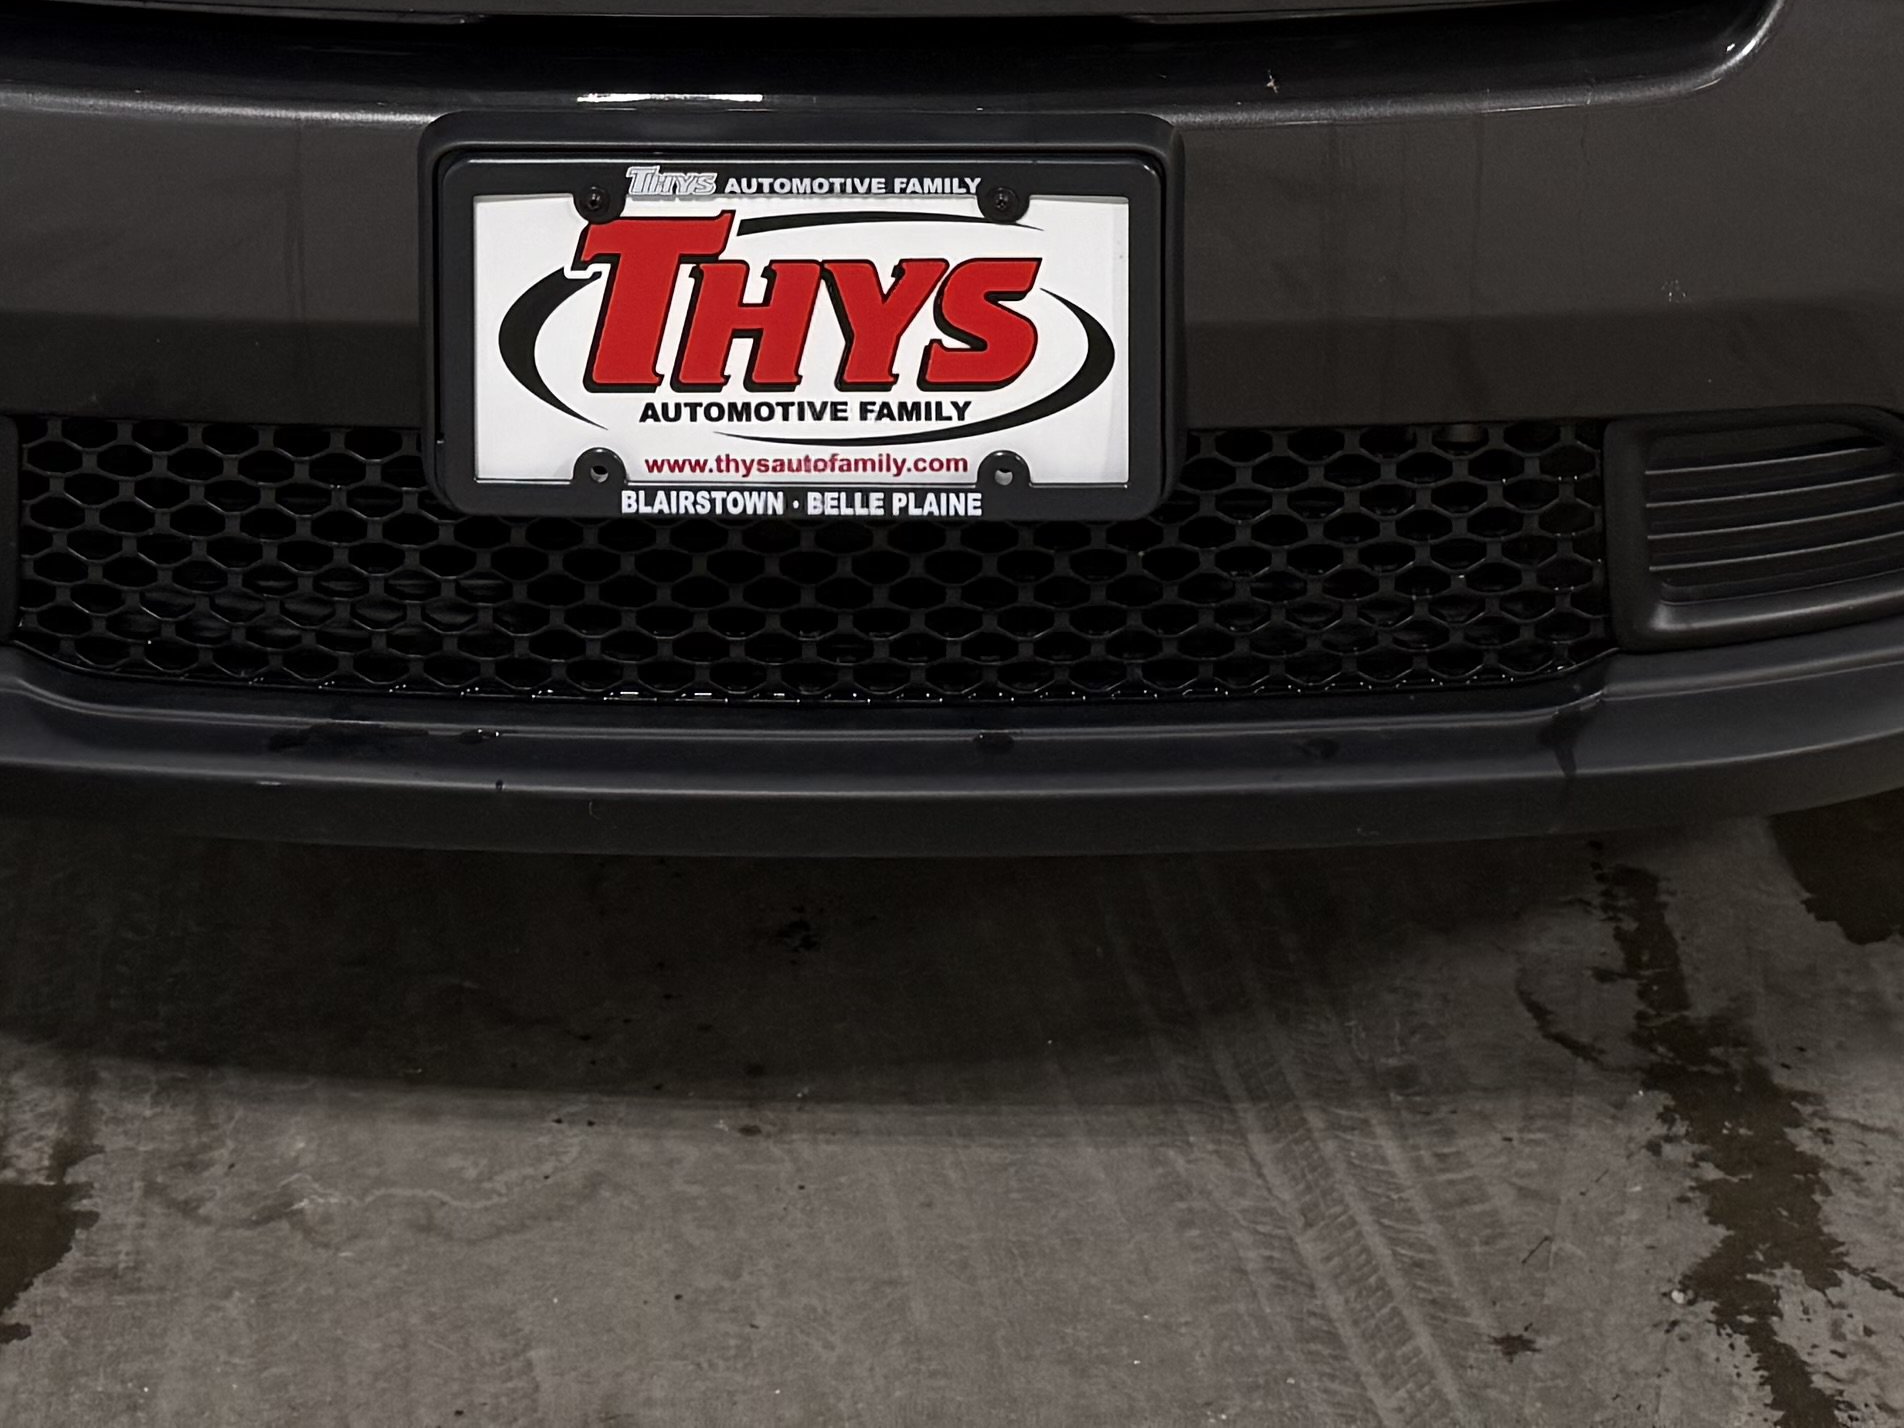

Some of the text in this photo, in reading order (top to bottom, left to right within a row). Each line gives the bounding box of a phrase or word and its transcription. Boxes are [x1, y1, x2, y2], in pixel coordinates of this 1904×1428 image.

[626, 165, 982, 198] THYS AUTOMOTIVE FAMILY
[571, 210, 1042, 392] THYS
[639, 400, 972, 423] AUTOMOTIVE FAMILY
[644, 453, 969, 478] www.thysautofamily.com
[621, 490, 983, 517] BLAIRSTOWN BELLE PLAINE
